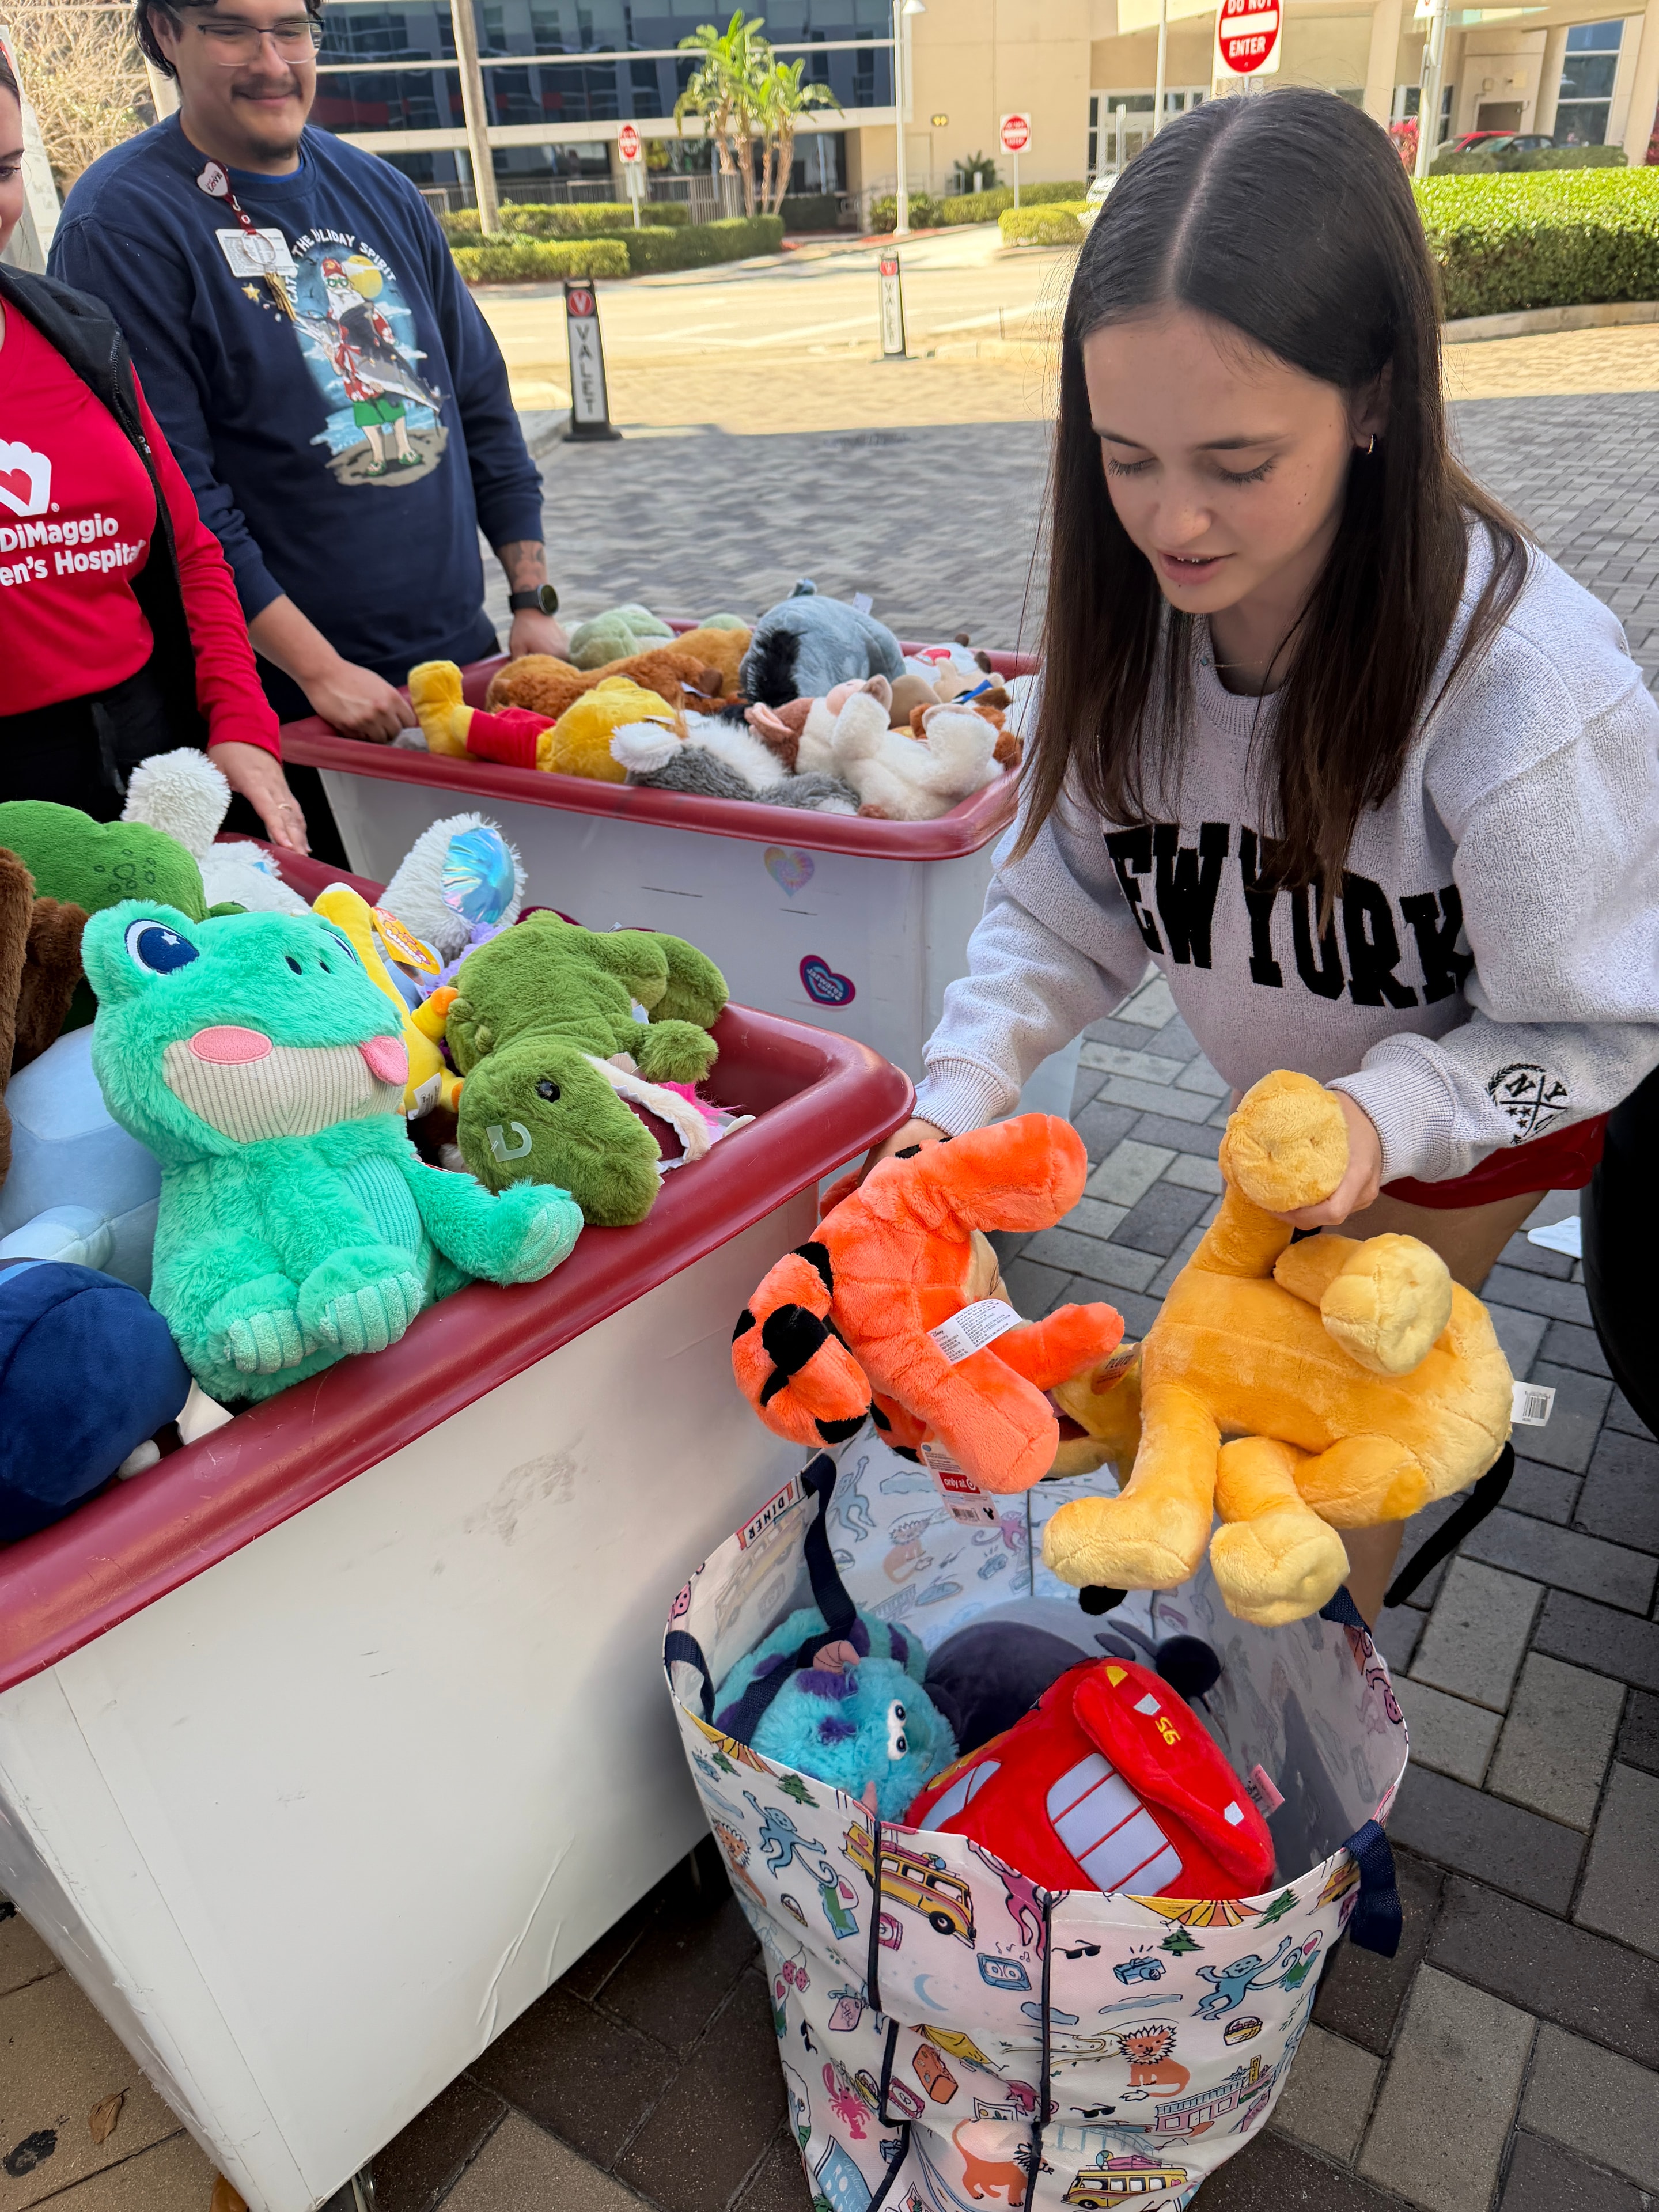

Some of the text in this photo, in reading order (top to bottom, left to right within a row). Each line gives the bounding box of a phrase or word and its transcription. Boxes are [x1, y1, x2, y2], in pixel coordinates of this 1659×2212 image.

[1228, 0, 1245, 15] DO
[1229, 35, 1266, 59] ENTER
[291, 234, 315, 257] THE
[359, 241, 396, 281] SPIRIT
[576, 324, 594, 415] VALET
[0, 513, 119, 553] DiMaggio
[806, 969, 843, 998] Jazwares
[944, 1478, 967, 1488] only at
[748, 1497, 785, 1539] DINER
[1154, 1716, 1181, 1745] 95
